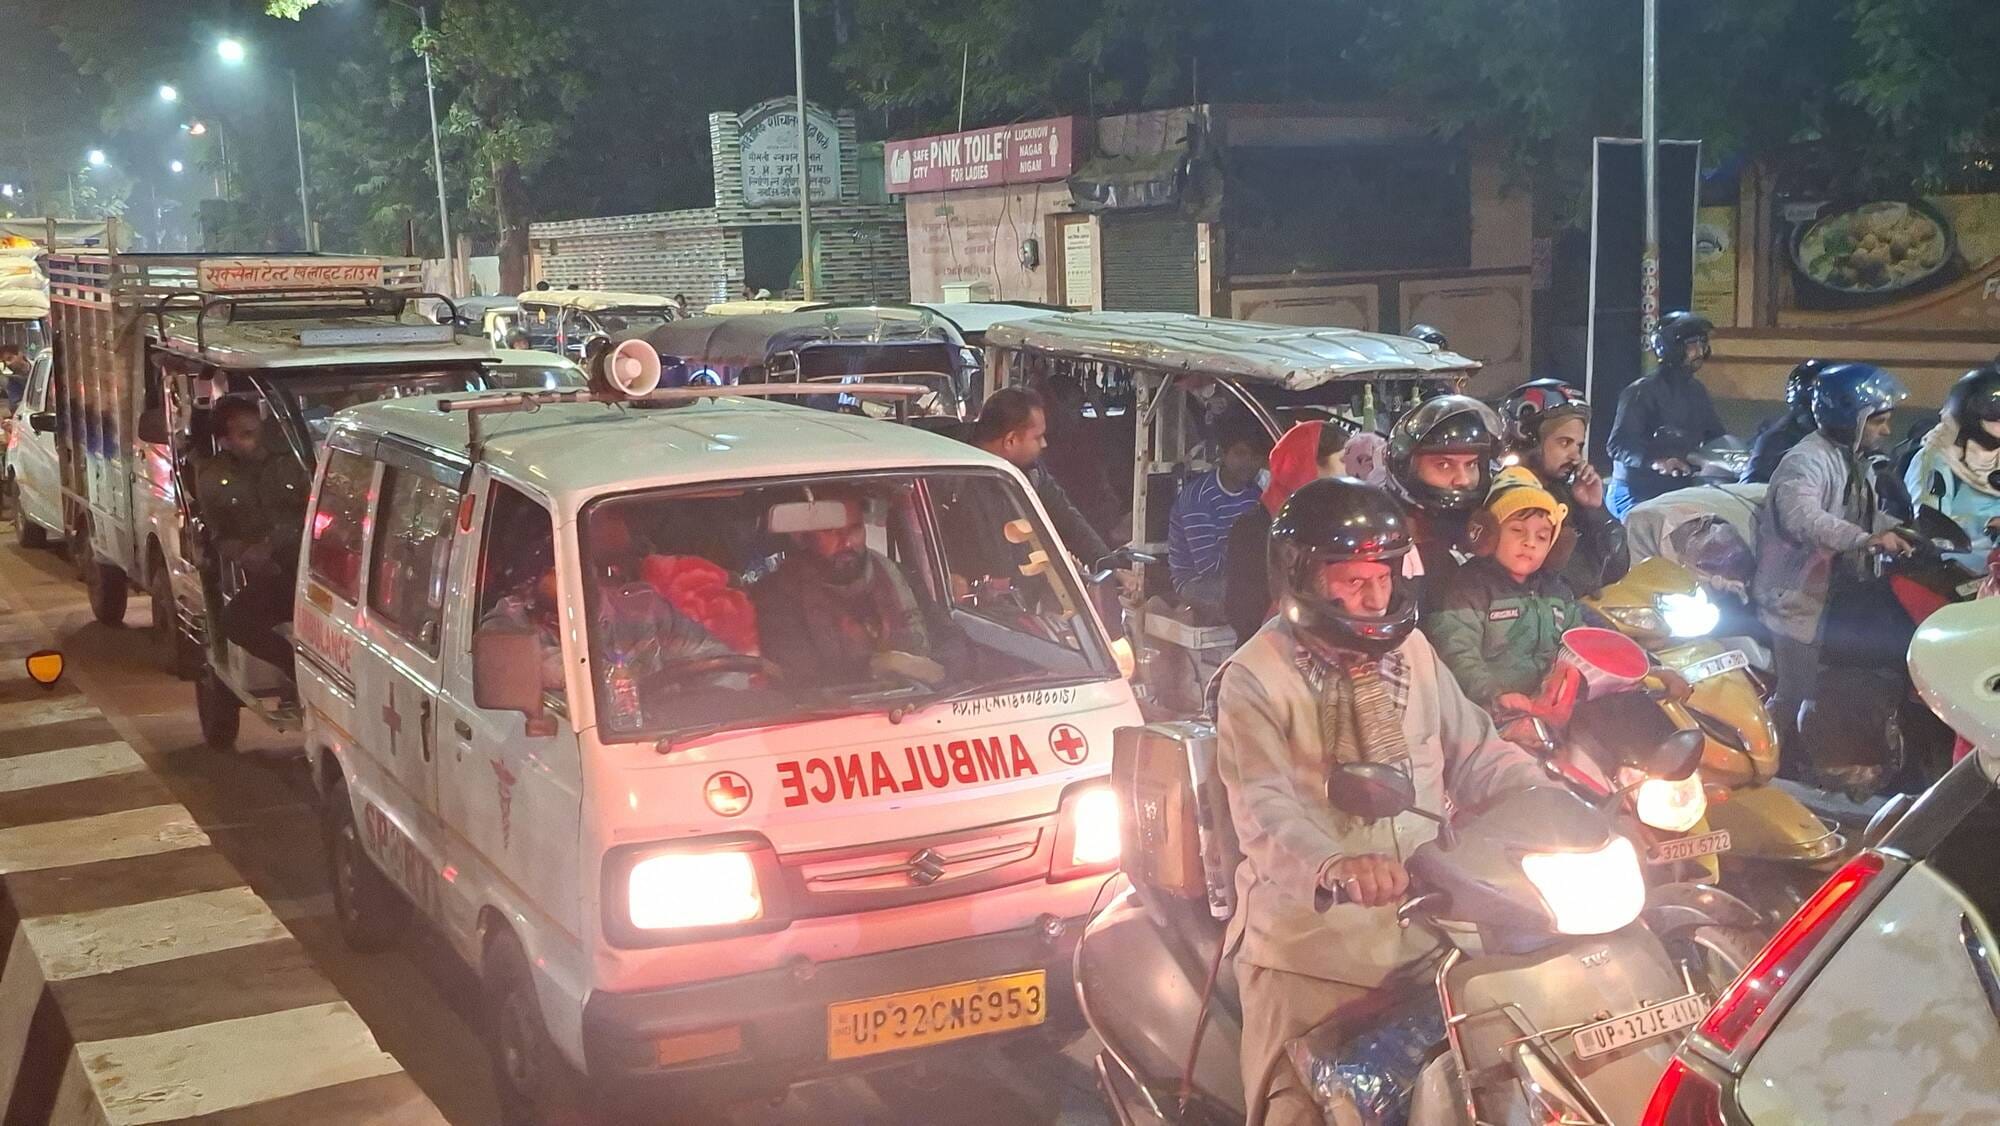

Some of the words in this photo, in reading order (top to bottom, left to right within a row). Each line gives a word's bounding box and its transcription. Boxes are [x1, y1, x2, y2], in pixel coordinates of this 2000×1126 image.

[1014, 125, 1049, 141] LUCKNOW
[912, 148, 930, 163] SAFE
[930, 137, 962, 169] PINK
[1019, 143, 1043, 158] NAGAR
[912, 165, 929, 180] CITY
[950, 169, 964, 183] FOR
[965, 164, 989, 181] LADIES
[1019, 159, 1043, 174] NIGAM
